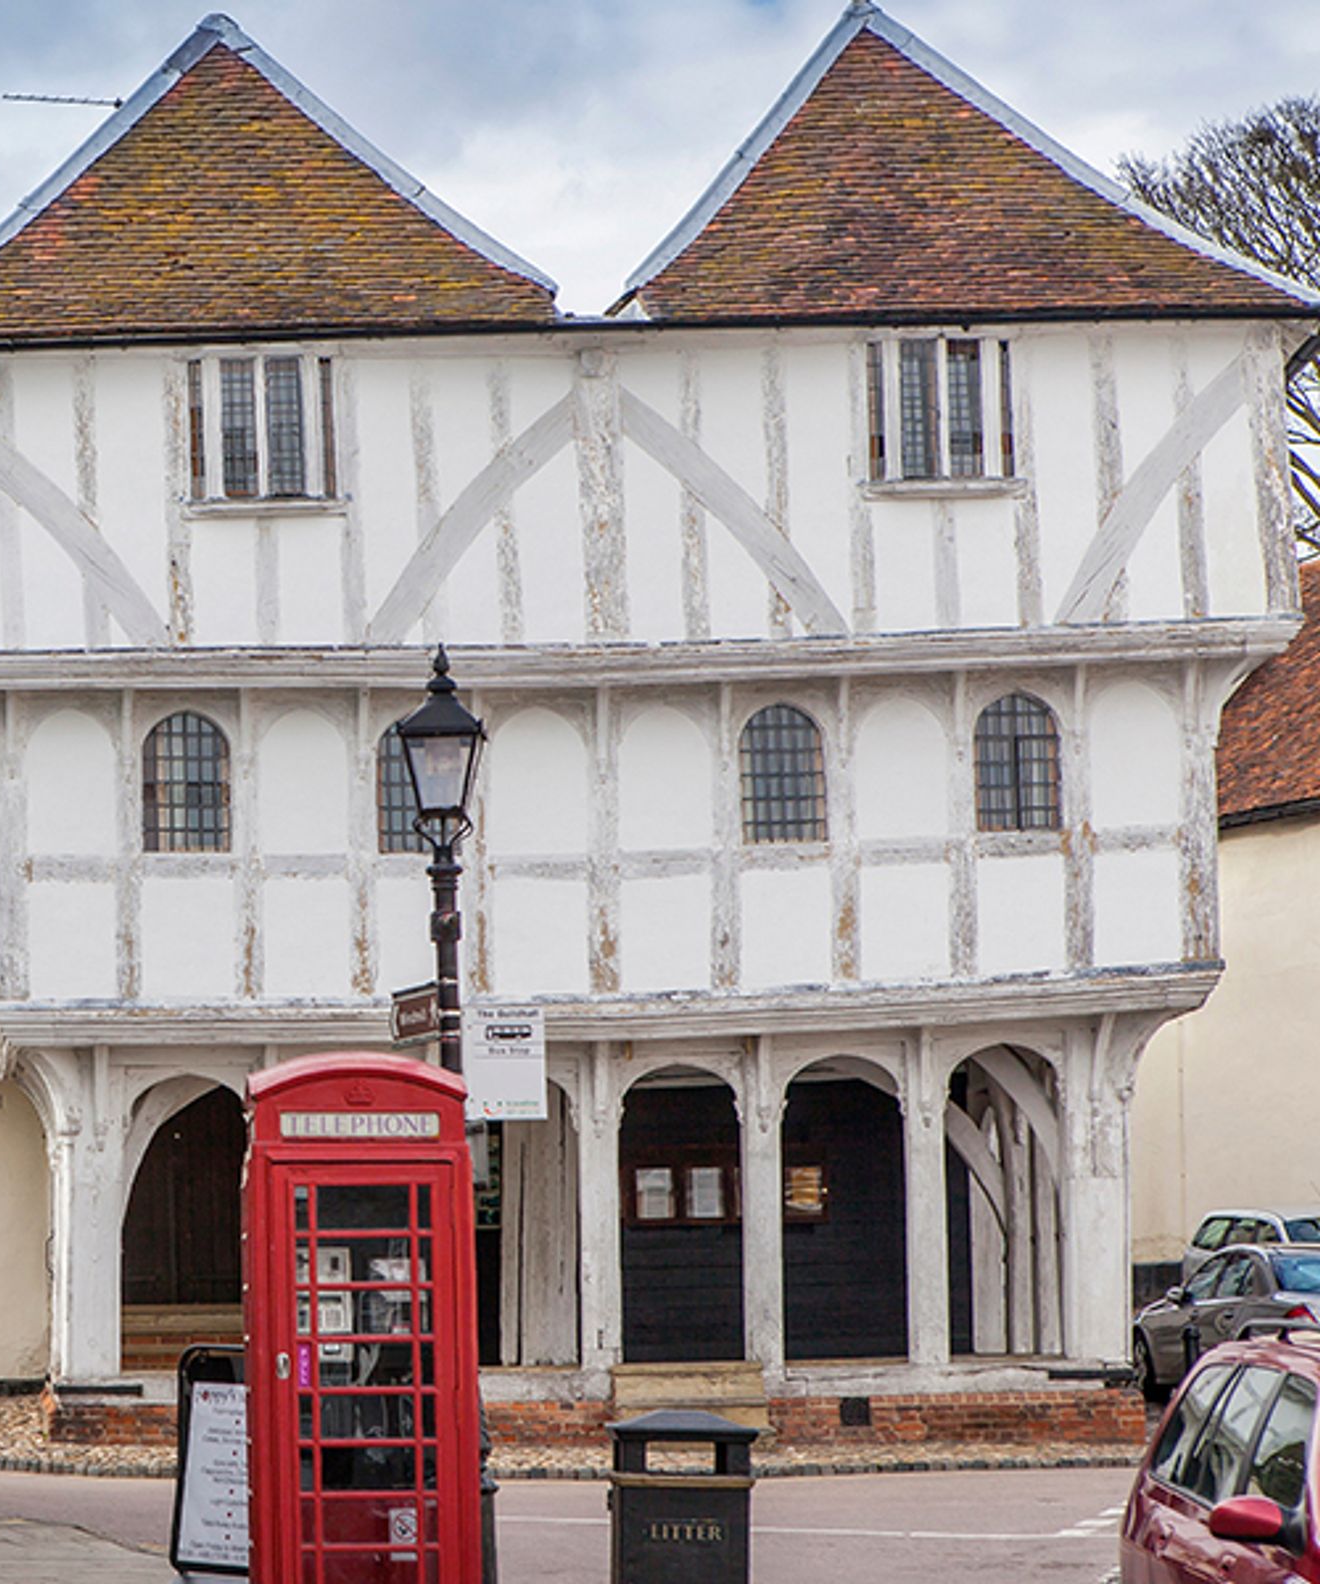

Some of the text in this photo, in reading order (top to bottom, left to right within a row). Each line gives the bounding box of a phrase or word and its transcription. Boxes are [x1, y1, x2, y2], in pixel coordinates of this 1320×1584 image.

[488, 1047, 530, 1056] Bus Stop
[289, 1115, 432, 1134] TELEPHONE
[650, 1523, 722, 1541] LITTER
